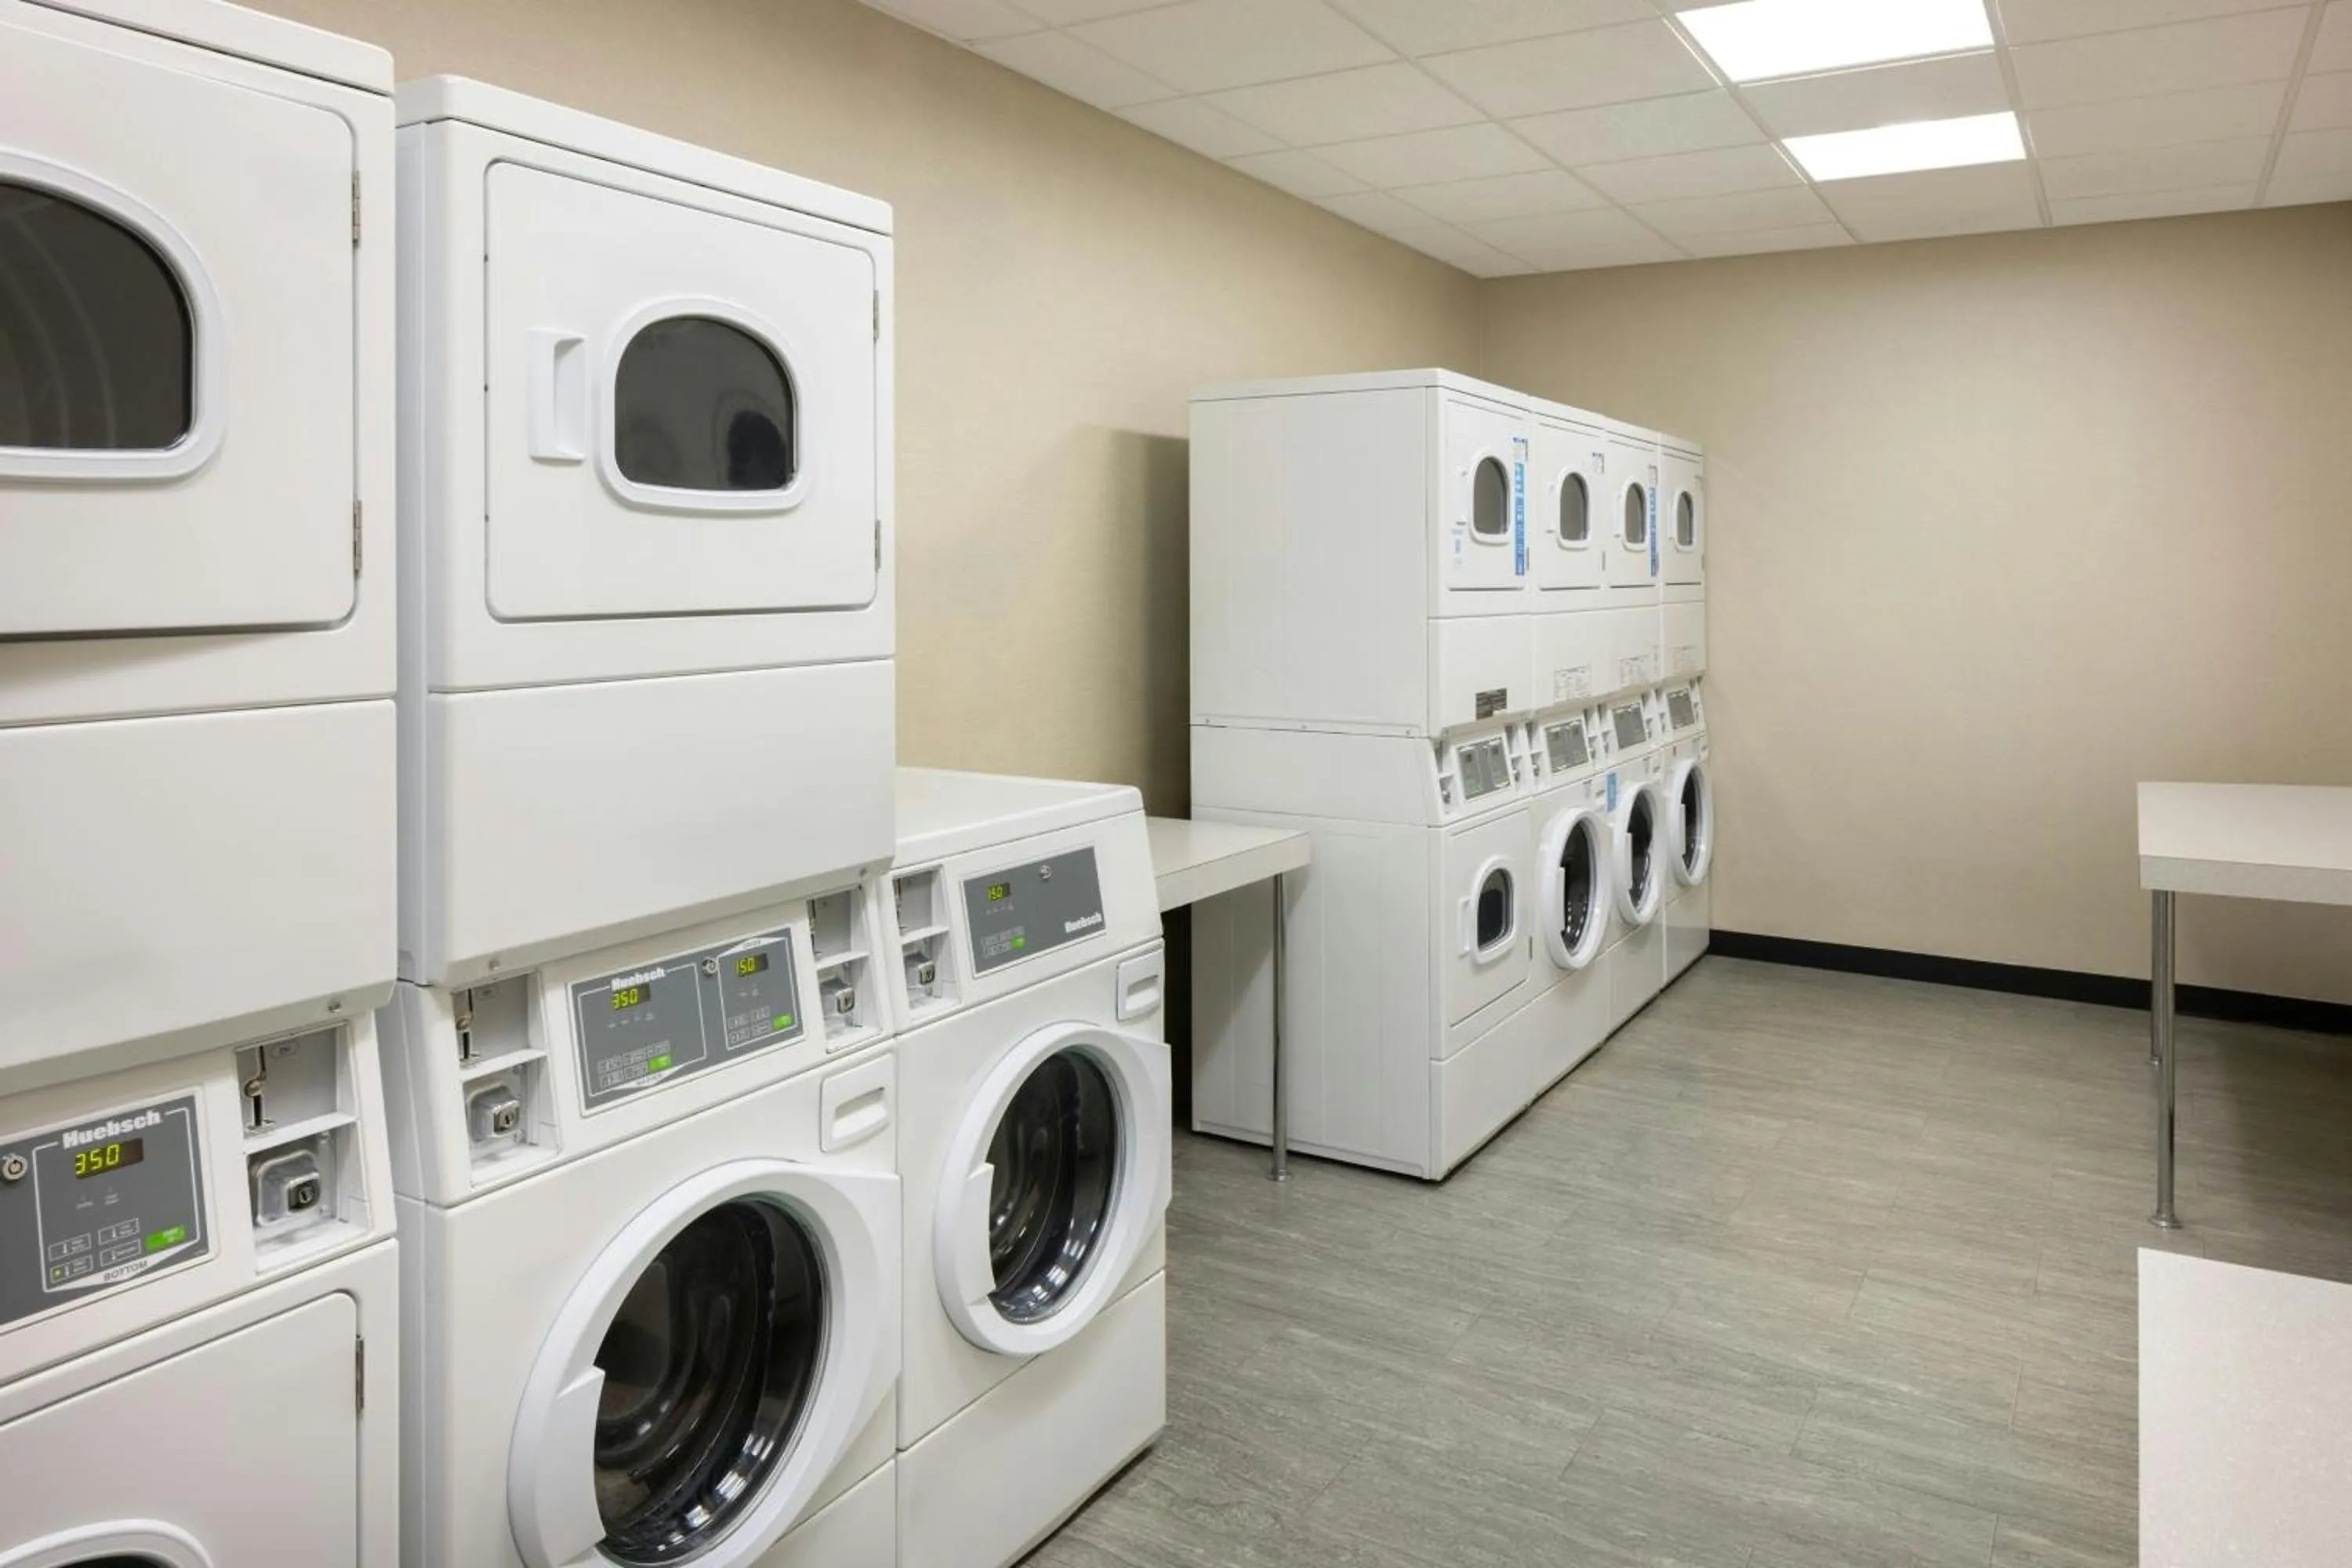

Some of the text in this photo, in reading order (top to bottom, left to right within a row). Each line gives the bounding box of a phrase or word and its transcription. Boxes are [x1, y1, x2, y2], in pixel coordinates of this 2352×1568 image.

[735, 956, 755, 975] 150
[612, 967, 666, 992] Huebsch
[613, 988, 638, 1010] 350
[62, 1109, 162, 1150] Huebsch
[74, 1143, 120, 1176] 350
[103, 1261, 148, 1282] BOTTOM
